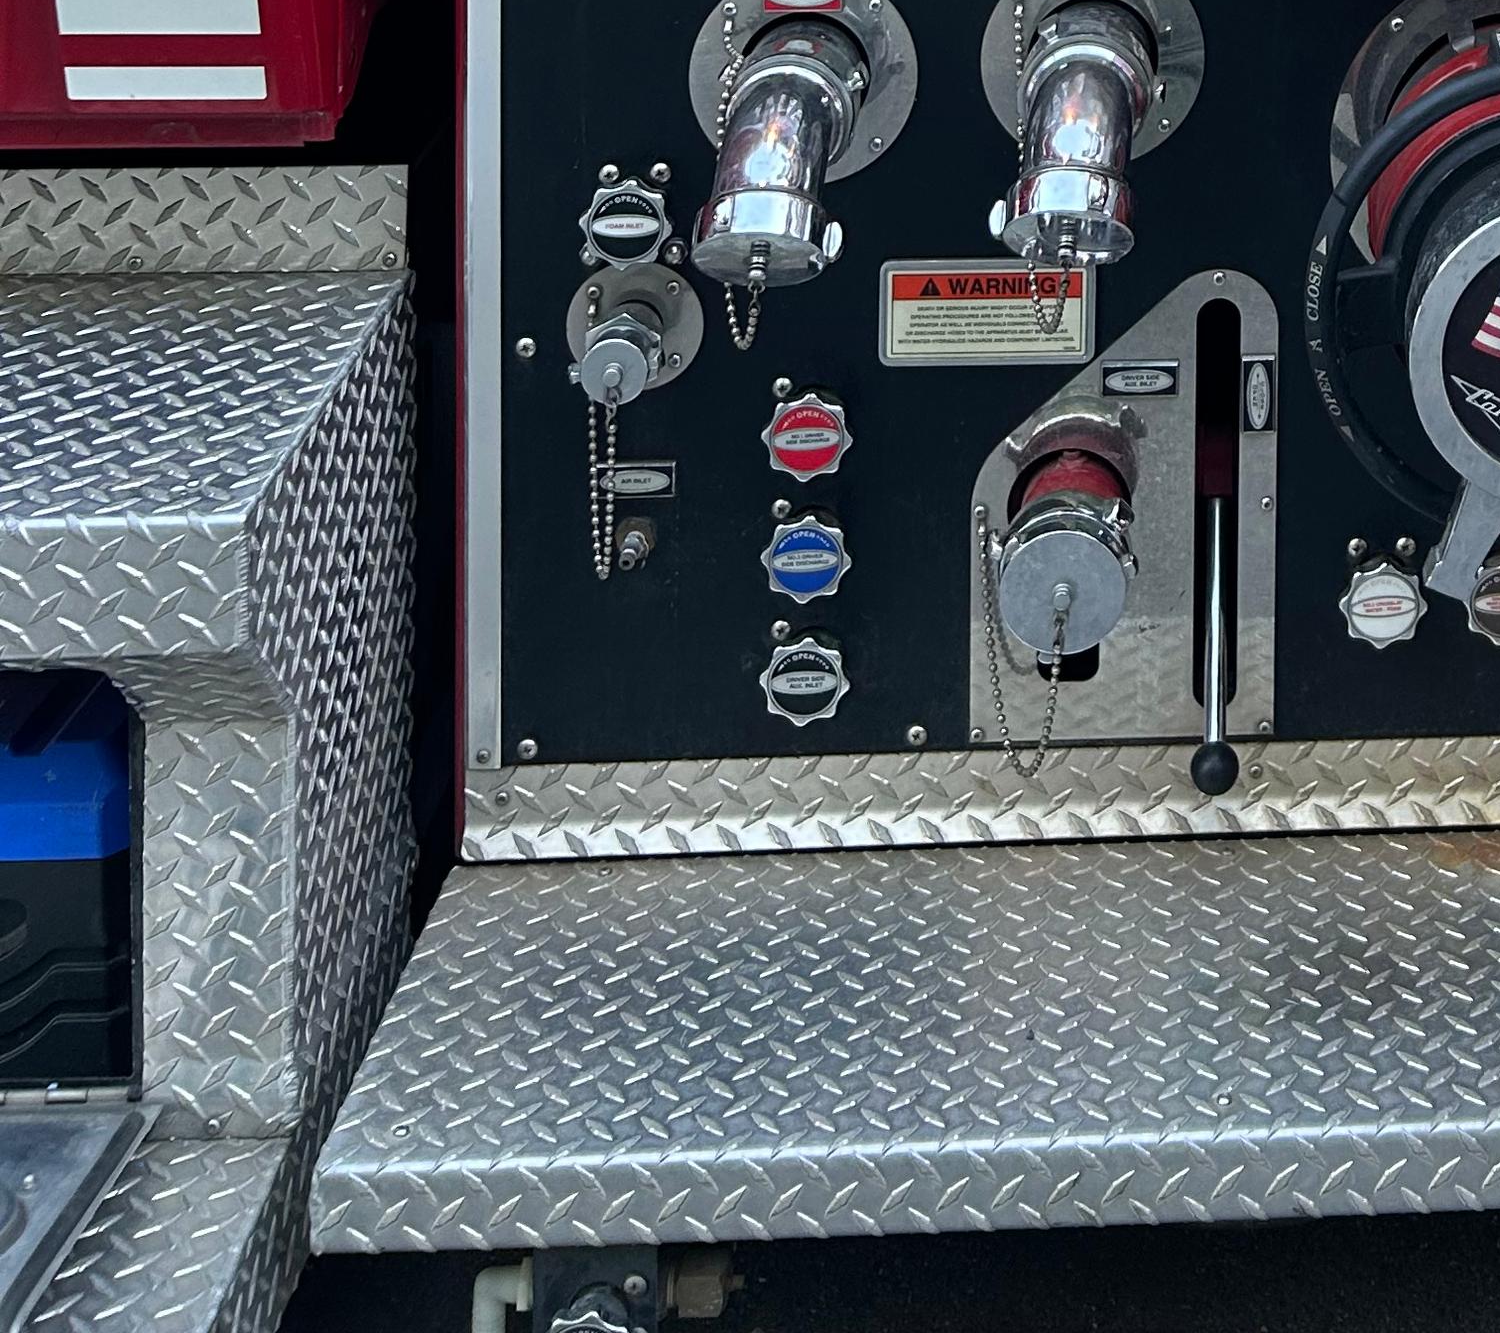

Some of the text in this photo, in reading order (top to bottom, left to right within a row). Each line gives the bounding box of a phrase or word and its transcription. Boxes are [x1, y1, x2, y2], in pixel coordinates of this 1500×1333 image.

[614, 195, 639, 204] OPEN
[1306, 262, 1324, 321] CLOSE
[1314, 369, 1342, 416] OPEN
[796, 410, 819, 419] OPEN
[792, 531, 816, 539] OPEN
[792, 653, 816, 661] OPEN
